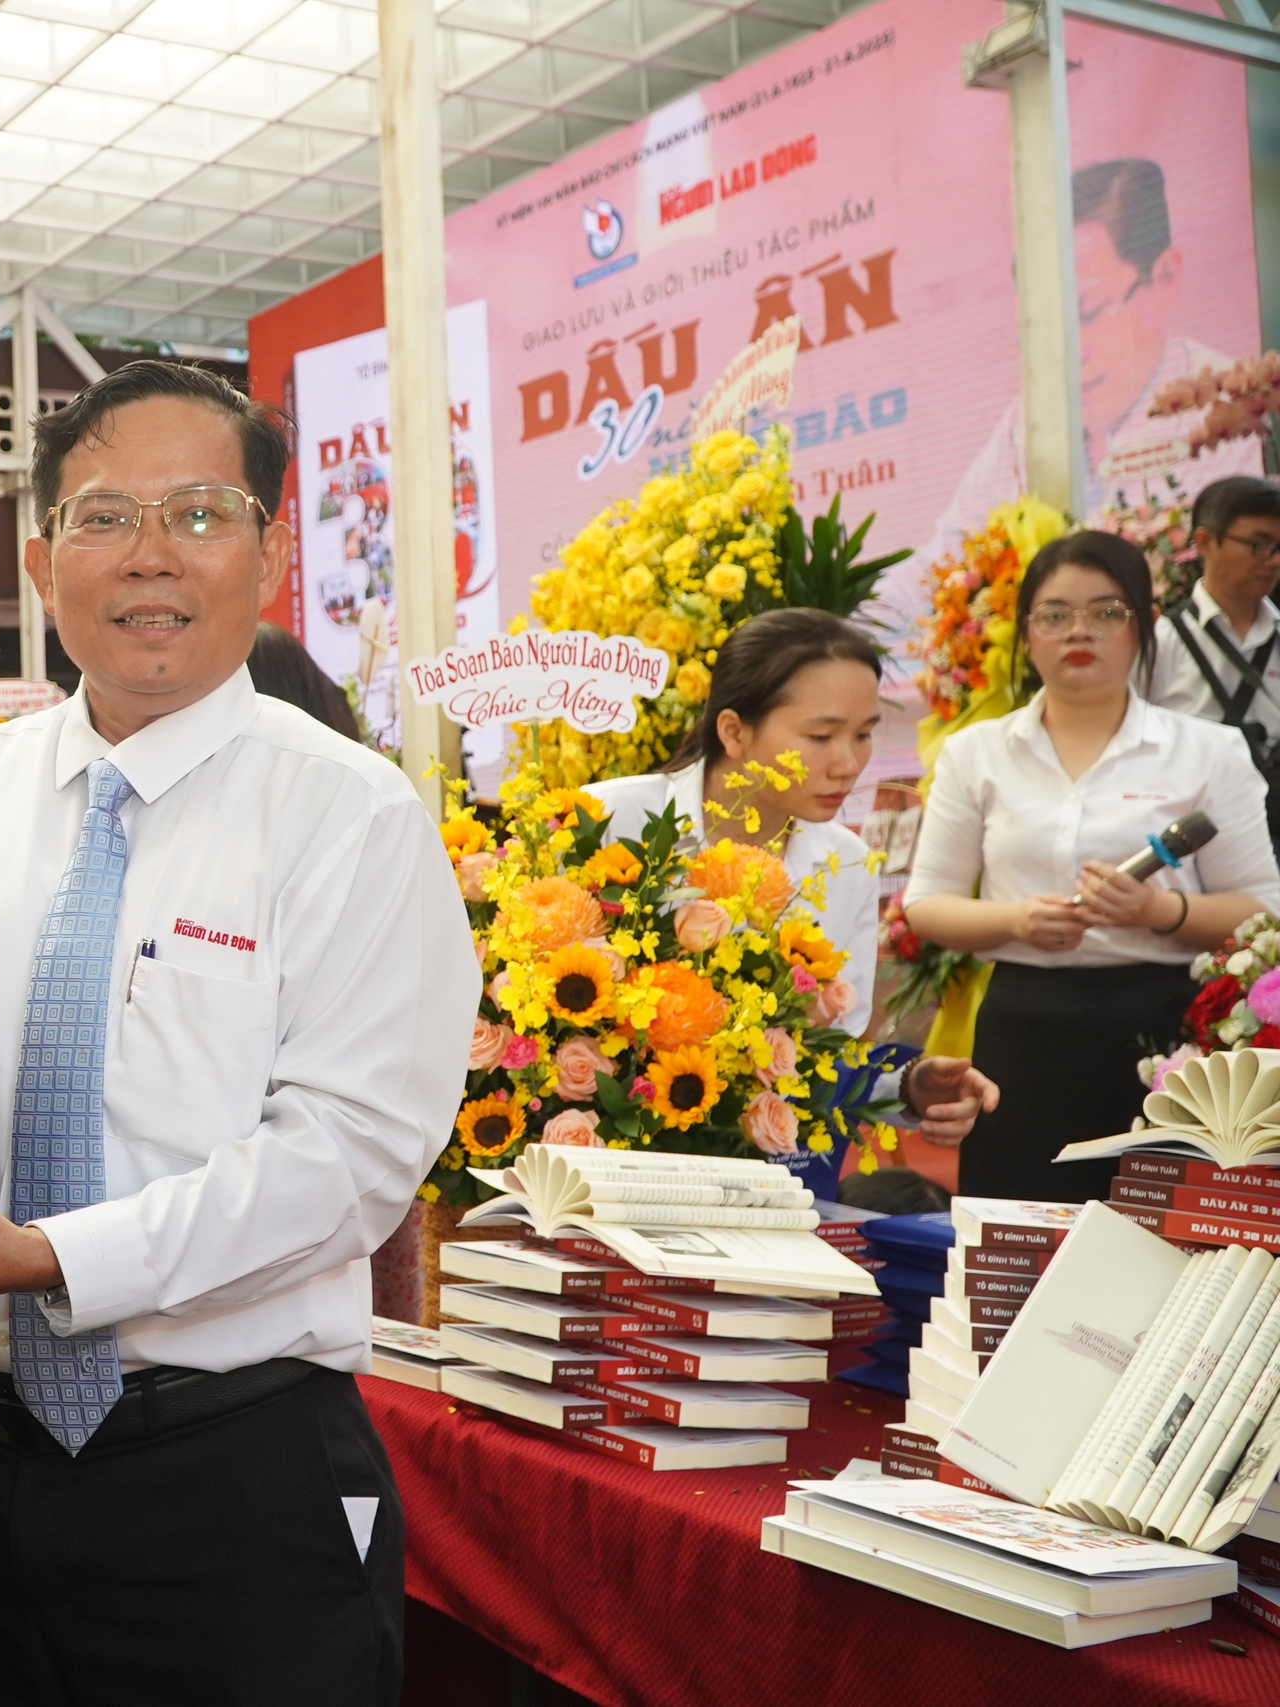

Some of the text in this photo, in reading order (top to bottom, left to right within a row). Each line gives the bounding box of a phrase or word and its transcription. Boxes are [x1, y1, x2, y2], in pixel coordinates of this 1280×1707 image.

[721, 160, 756, 202] LAO
[523, 197, 876, 352] GIAO LƯU VÀ GIỚI THIỆU TÁC PHẨM
[519, 319, 701, 443] DẤU
[751, 246, 901, 355] ẤN
[796, 386, 909, 450] BÁO
[583, 392, 659, 474] 30
[813, 458, 897, 498] Tuân
[411, 633, 663, 697] Tòa Soạn Báo Người Lao Động
[449, 678, 631, 731] Chúc Mừng
[173, 923, 207, 940] NGƯỜI
[207, 930, 230, 946] LAO
[1130, 1162, 1140, 1171] TÔ
[1140, 1163, 1158, 1174] ĐÌNH
[1159, 1165, 1179, 1176] TUÂN
[1119, 1186, 1128, 1196] TÔ
[1129, 1187, 1147, 1199] ĐÌNH
[1148, 1190, 1167, 1201] TUÂN
[1251, 1204, 1269, 1215] 30
[992, 1231, 1048, 1244] TÔ ĐÌNH TUÂN
[1139, 1215, 1158, 1227] TUÂN
[1242, 1230, 1260, 1241] 30
[976, 1254, 1031, 1267] TÔ ĐÌNH TUÂN
[976, 1281, 1031, 1294] TÔ ĐÌNH TUÂN
[981, 1307, 991, 1317] TÔ
[993, 1308, 1013, 1318] ĐÌNH
[984, 1335, 995, 1346] TÔ
[892, 1436, 936, 1453] TÔ ĐÌNH TUÂN
[889, 1460, 898, 1470] TÔ
[899, 1463, 915, 1474] ĐÌNH
[915, 1466, 933, 1478] TUÂN
